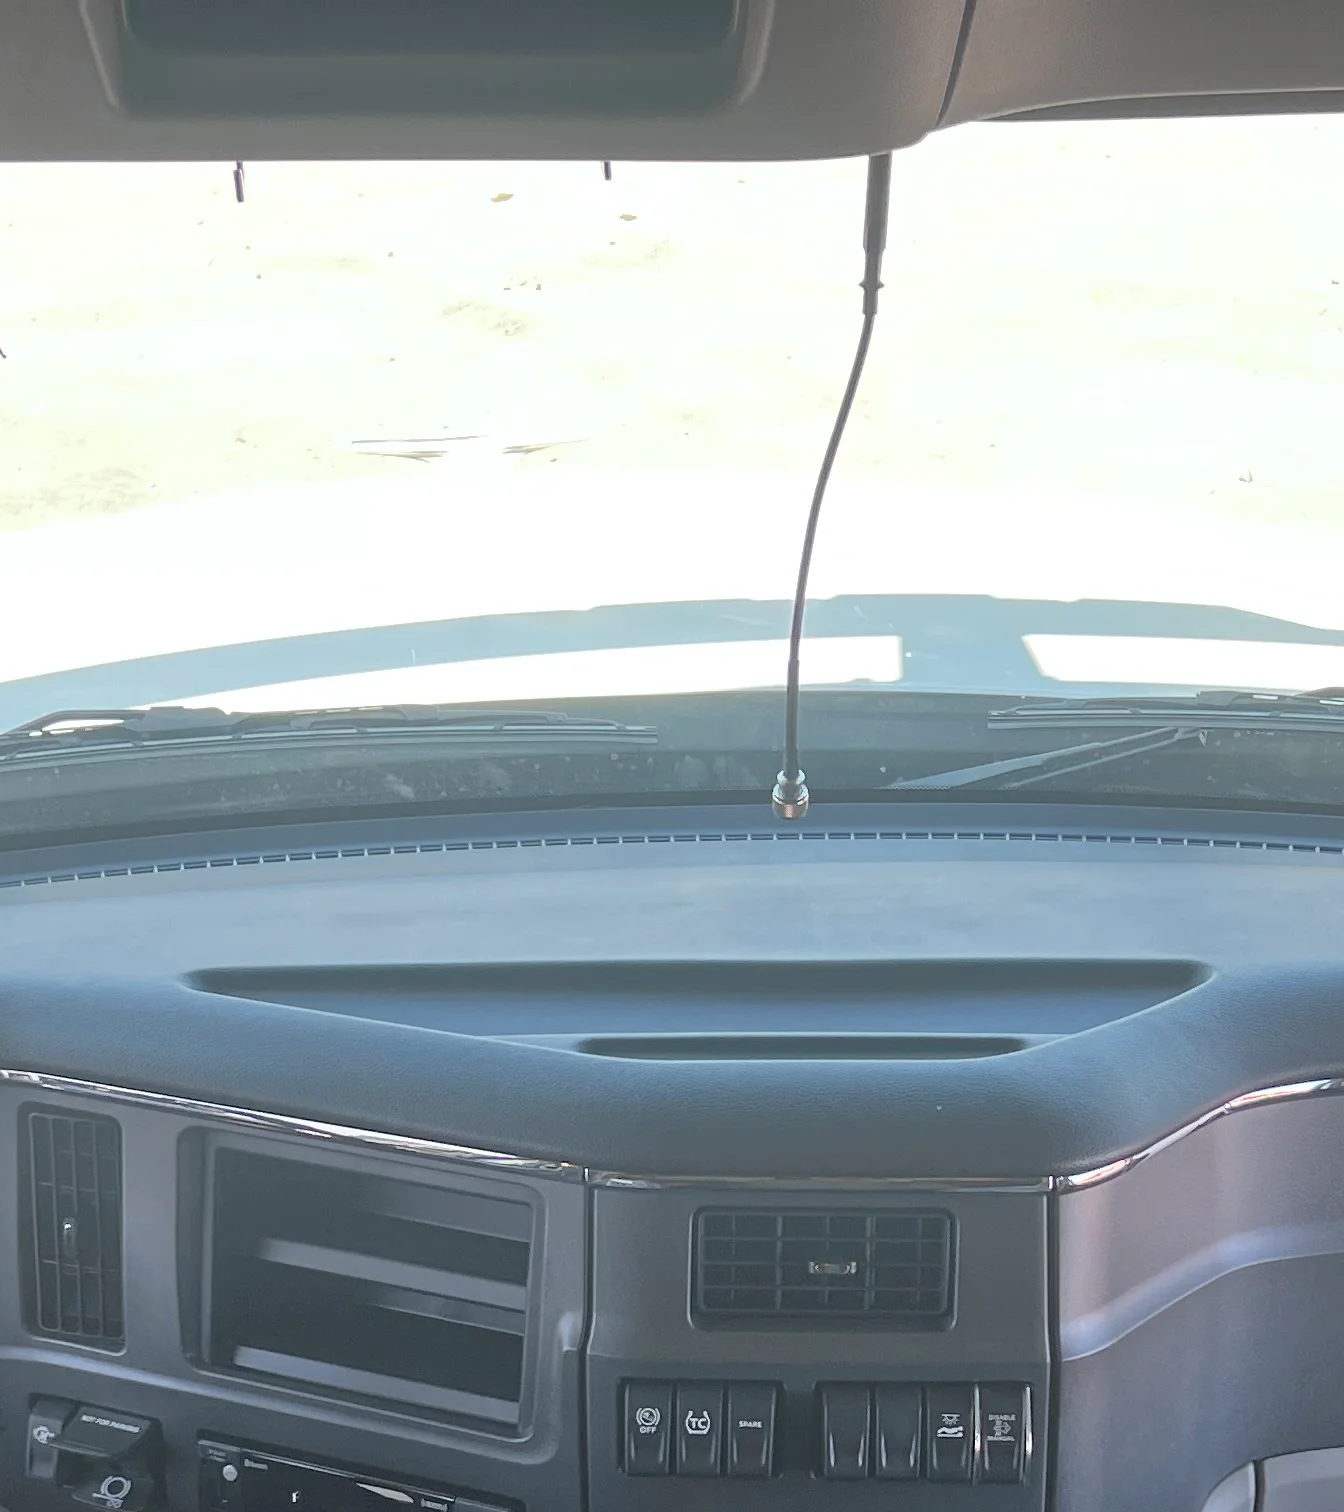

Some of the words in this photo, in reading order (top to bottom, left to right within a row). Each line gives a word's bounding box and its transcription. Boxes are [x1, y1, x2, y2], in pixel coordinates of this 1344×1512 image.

[689, 1417, 707, 1430] TC
[738, 1420, 763, 1429] SPARE
[639, 1425, 657, 1434] OFF
